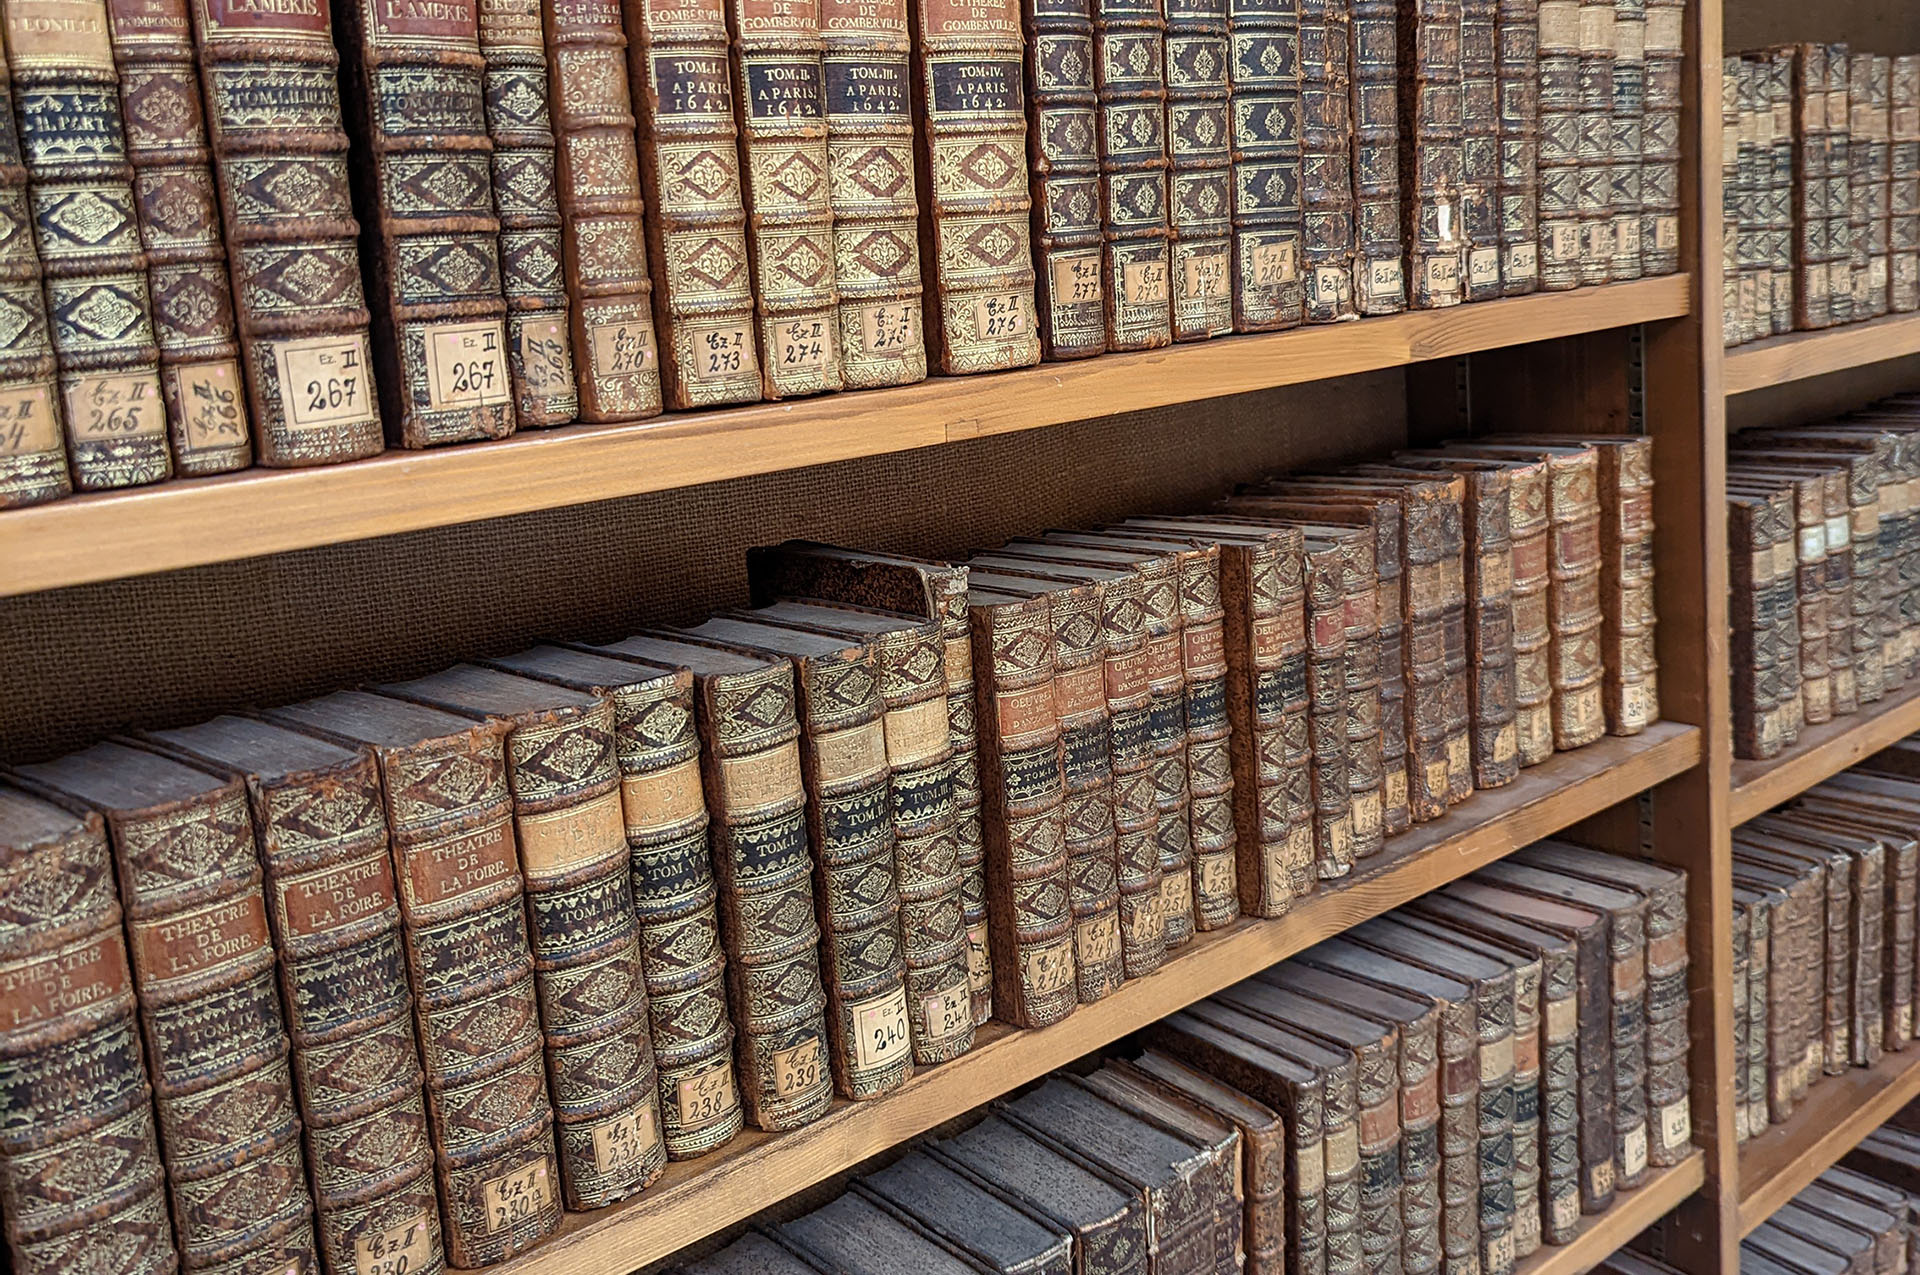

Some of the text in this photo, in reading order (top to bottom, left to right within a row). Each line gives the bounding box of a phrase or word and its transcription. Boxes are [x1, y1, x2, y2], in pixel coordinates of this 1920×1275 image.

[773, 2, 792, 14] DE
[858, 5, 877, 17] DE
[971, 7, 988, 18] DE
[672, 82, 684, 94] A
[758, 90, 770, 101] A
[846, 86, 856, 97] A
[955, 83, 966, 95] A
[1071, 281, 1099, 300] 277
[1008, 295, 1020, 312] II
[636, 329, 649, 348] II
[811, 322, 824, 338] II
[482, 332, 498, 352] II
[784, 341, 823, 364] 274
[341, 349, 359, 369] II
[611, 350, 644, 371] 270
[708, 351, 741, 373] 273
[452, 359, 495, 393] 267
[126, 381, 149, 402] II
[306, 376, 357, 413] 267
[17, 399, 33, 418] II
[87, 407, 142, 433] 265
[431, 828, 504, 864] THEATRE
[456, 854, 480, 871] DE
[300, 860, 382, 898] THEATRE
[440, 859, 510, 896] LA FOIRE.
[332, 886, 356, 903] DE
[160, 900, 250, 943] THEATRE
[309, 909, 336, 928] LA
[196, 928, 222, 949] DE
[200, 933, 259, 963] FOIRE.
[3, 945, 102, 992] THEATRE
[44, 974, 73, 996] DE
[959, 987, 968, 1001] II
[13, 1004, 42, 1025] LA
[894, 997, 905, 1016] II
[943, 1004, 968, 1032] 241
[874, 1017, 906, 1053] 240
[720, 1068, 730, 1090] II
[784, 1064, 815, 1092] 239
[689, 1091, 723, 1120] 238
[404, 1224, 420, 1248] II
